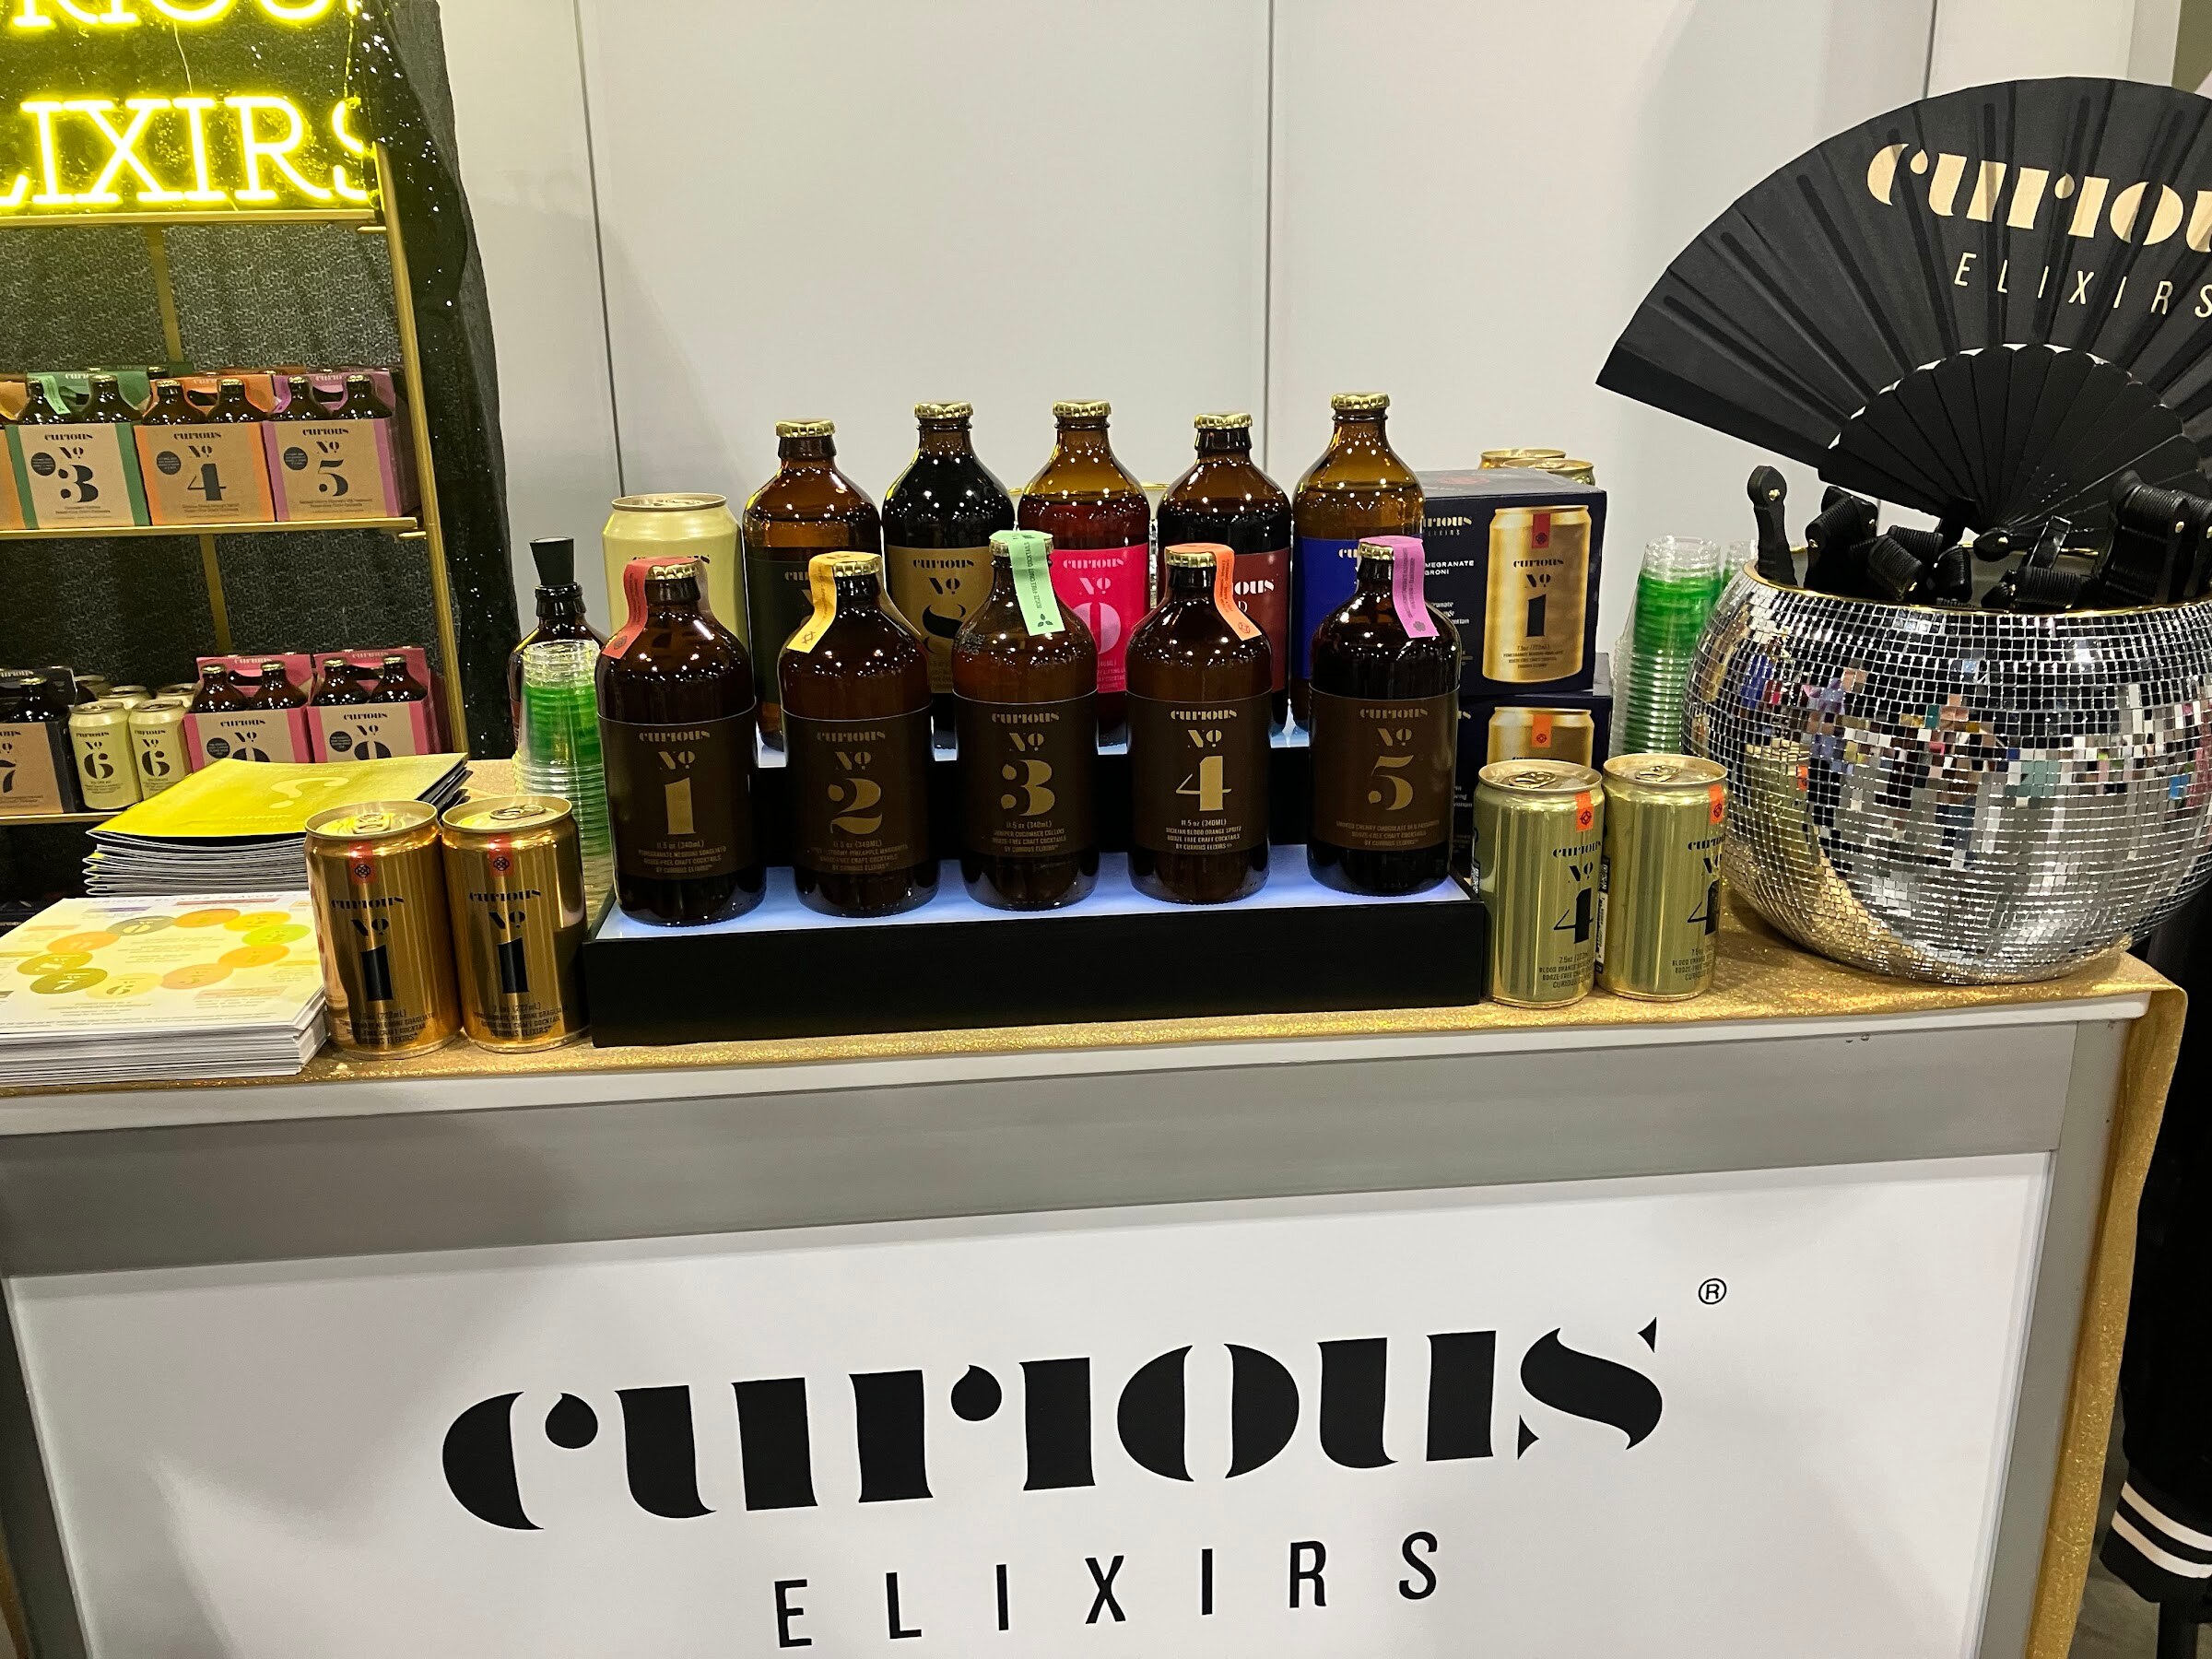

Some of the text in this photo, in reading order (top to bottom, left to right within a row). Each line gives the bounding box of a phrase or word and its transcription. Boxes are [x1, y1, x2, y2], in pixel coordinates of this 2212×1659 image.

[1867, 143, 2212, 254] curio
[173, 432, 222, 441] curious
[57, 465, 99, 503] 3
[187, 463, 227, 501] 4
[317, 459, 349, 497] 5
[1423, 516, 1473, 528] rious
[913, 559, 975, 569] curious
[1063, 557, 1124, 569] curious
[1424, 569, 1451, 577] GRONI
[1513, 559, 1565, 569] curious
[1525, 594, 1547, 638] 1
[991, 712, 1060, 724] curious
[1171, 710, 1238, 721] curious
[1359, 708, 1429, 719] curious
[638, 730, 712, 742] curious
[817, 731, 886, 743] curious
[83, 752, 114, 780] 6
[141, 750, 171, 778] 6
[1001, 759, 1055, 817] 3
[1176, 755, 1232, 812] 4
[1368, 754, 1414, 811] 5
[665, 777, 697, 835] 1
[828, 777, 883, 835] 2
[1186, 828, 1205, 836] BLOOD
[1205, 828, 1225, 836] ORANGE
[1201, 818, 1228, 828] (340ML)
[1214, 832, 1241, 842] COCKTAILS
[332, 896, 406, 912] curious
[469, 889, 542, 903] curious
[1687, 878, 1721, 936] 4
[1552, 887, 1594, 945] 4
[360, 944, 394, 1002] 1
[498, 935, 530, 994] 1
[441, 1315, 1665, 1531] curious
[774, 1530, 1440, 1650] ELIXIRS
